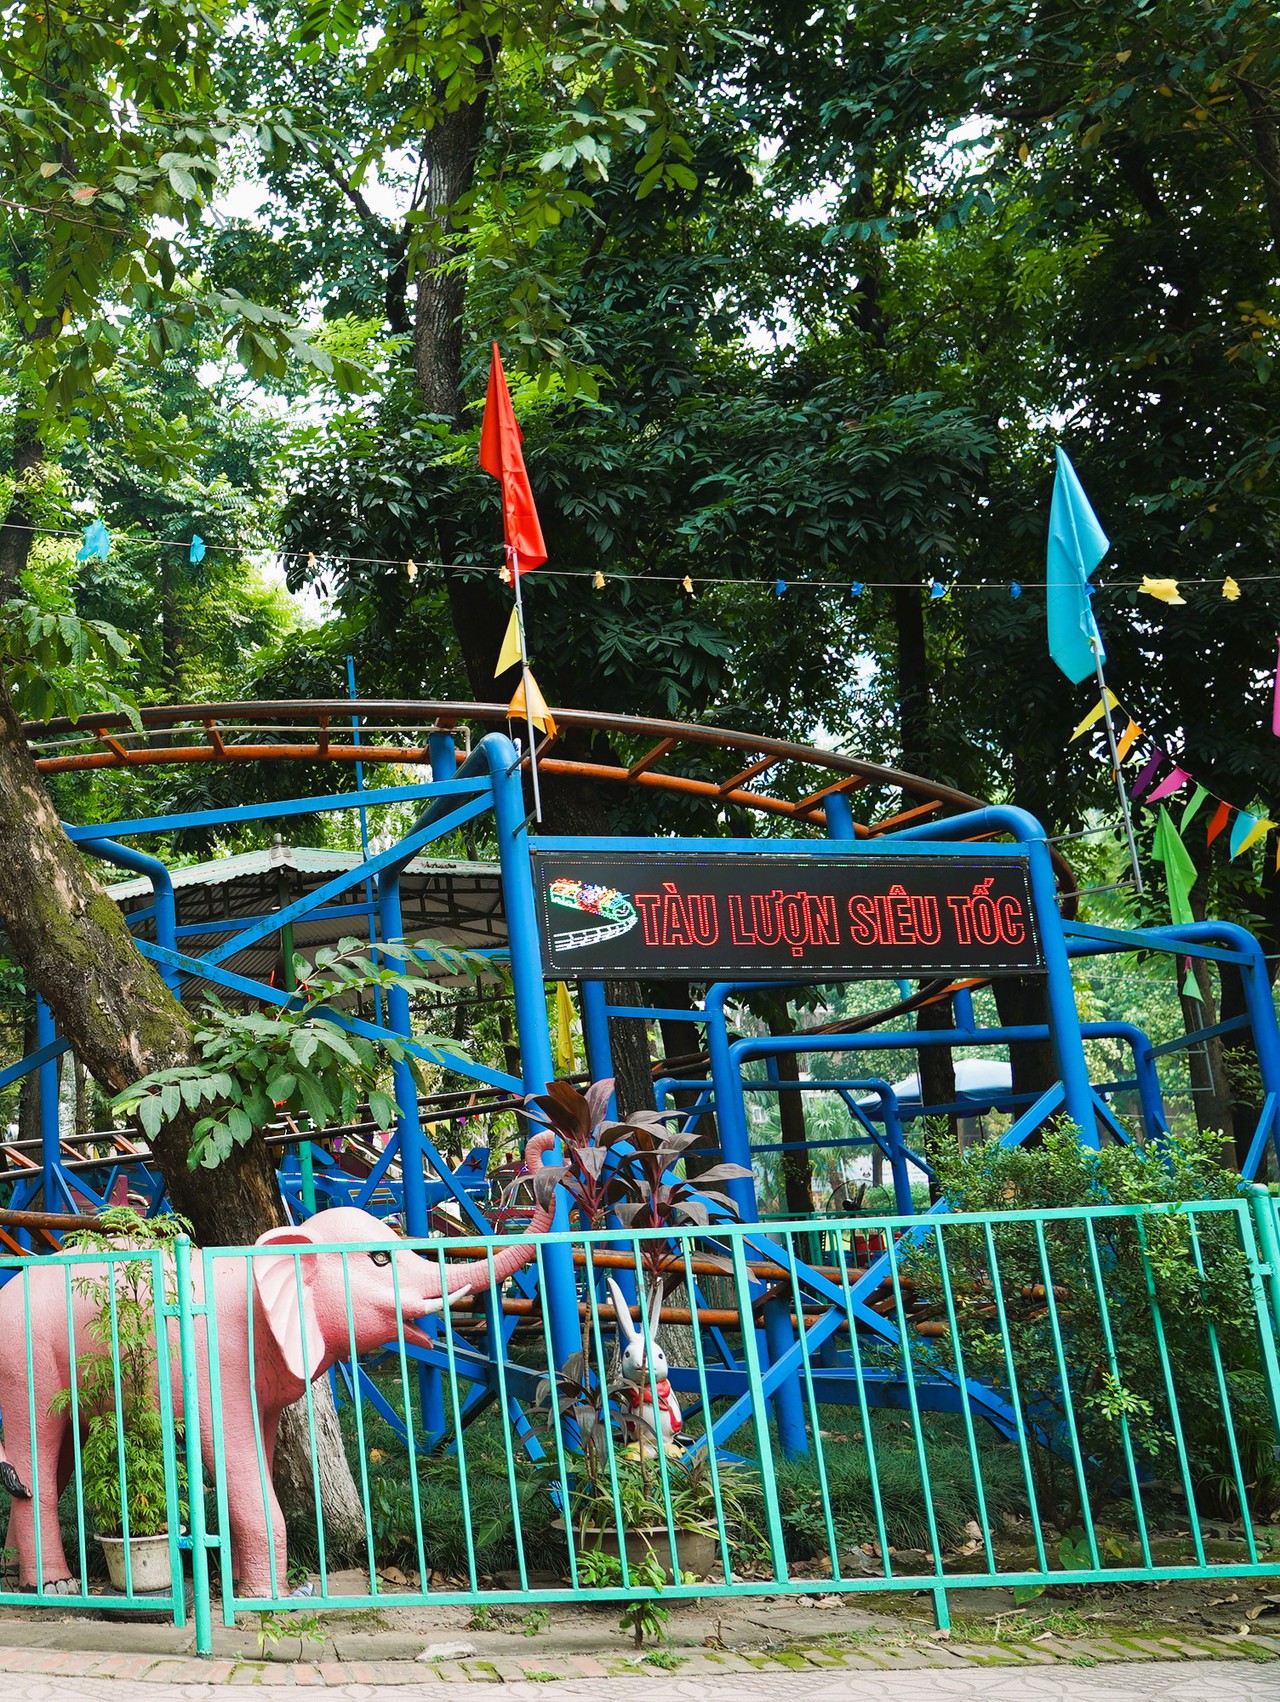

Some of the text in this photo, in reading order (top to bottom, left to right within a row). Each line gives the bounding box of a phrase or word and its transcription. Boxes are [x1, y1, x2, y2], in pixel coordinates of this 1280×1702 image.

[634, 877, 1026, 957] TÀU LƯỢN SIÊU TỐC
